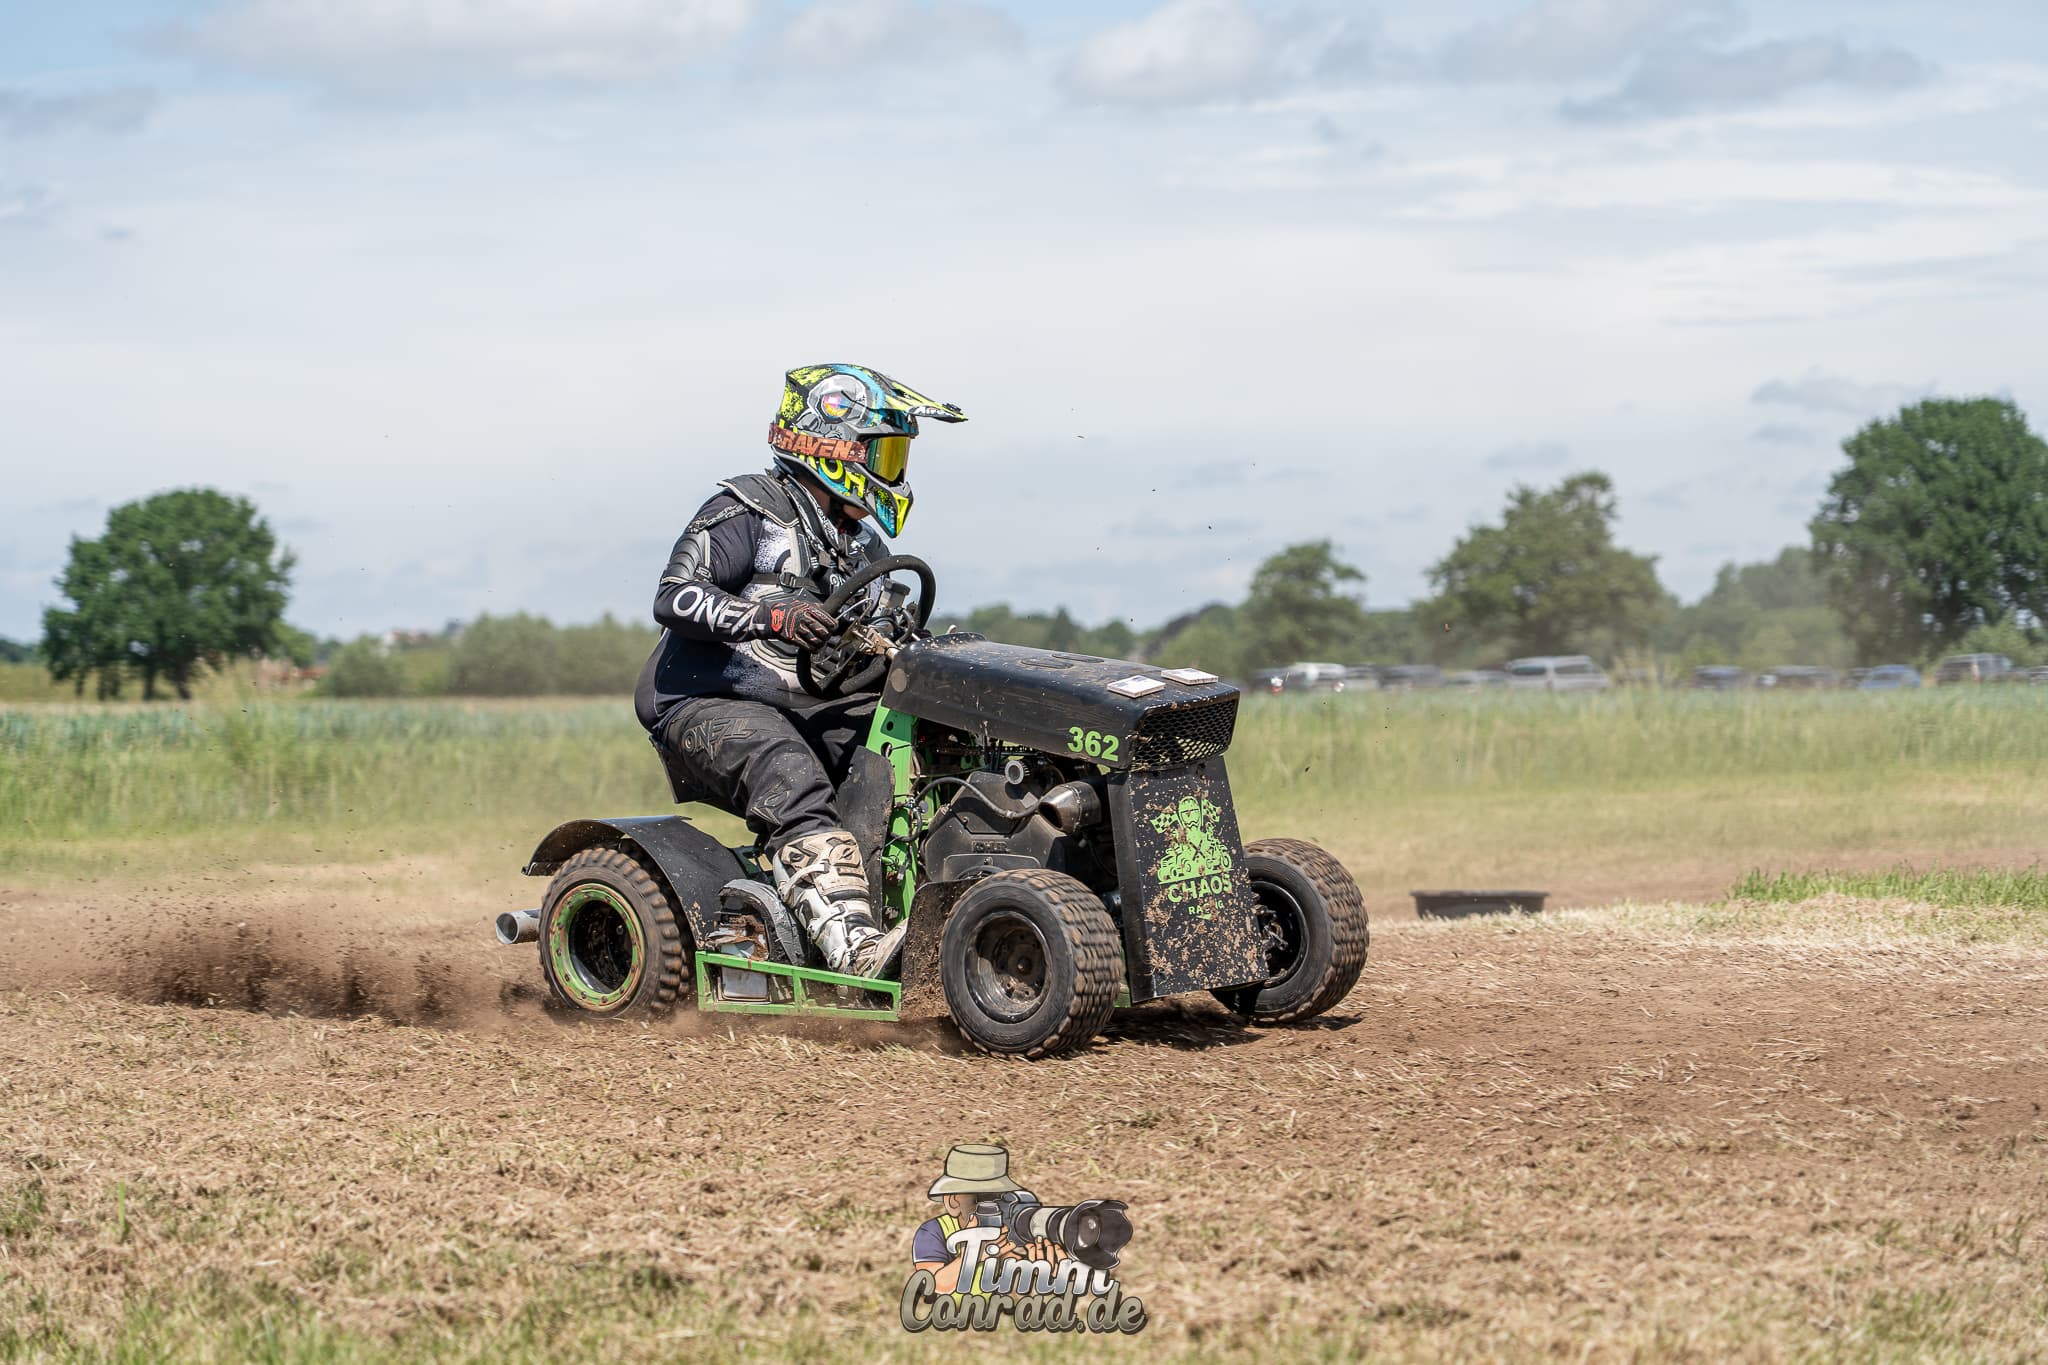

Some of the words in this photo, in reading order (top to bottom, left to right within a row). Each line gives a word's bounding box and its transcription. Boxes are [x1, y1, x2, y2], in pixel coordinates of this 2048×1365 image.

[781, 429, 853, 459] RAVEN
[1067, 726, 1119, 761] 362
[1167, 873, 1233, 903] CHAOS
